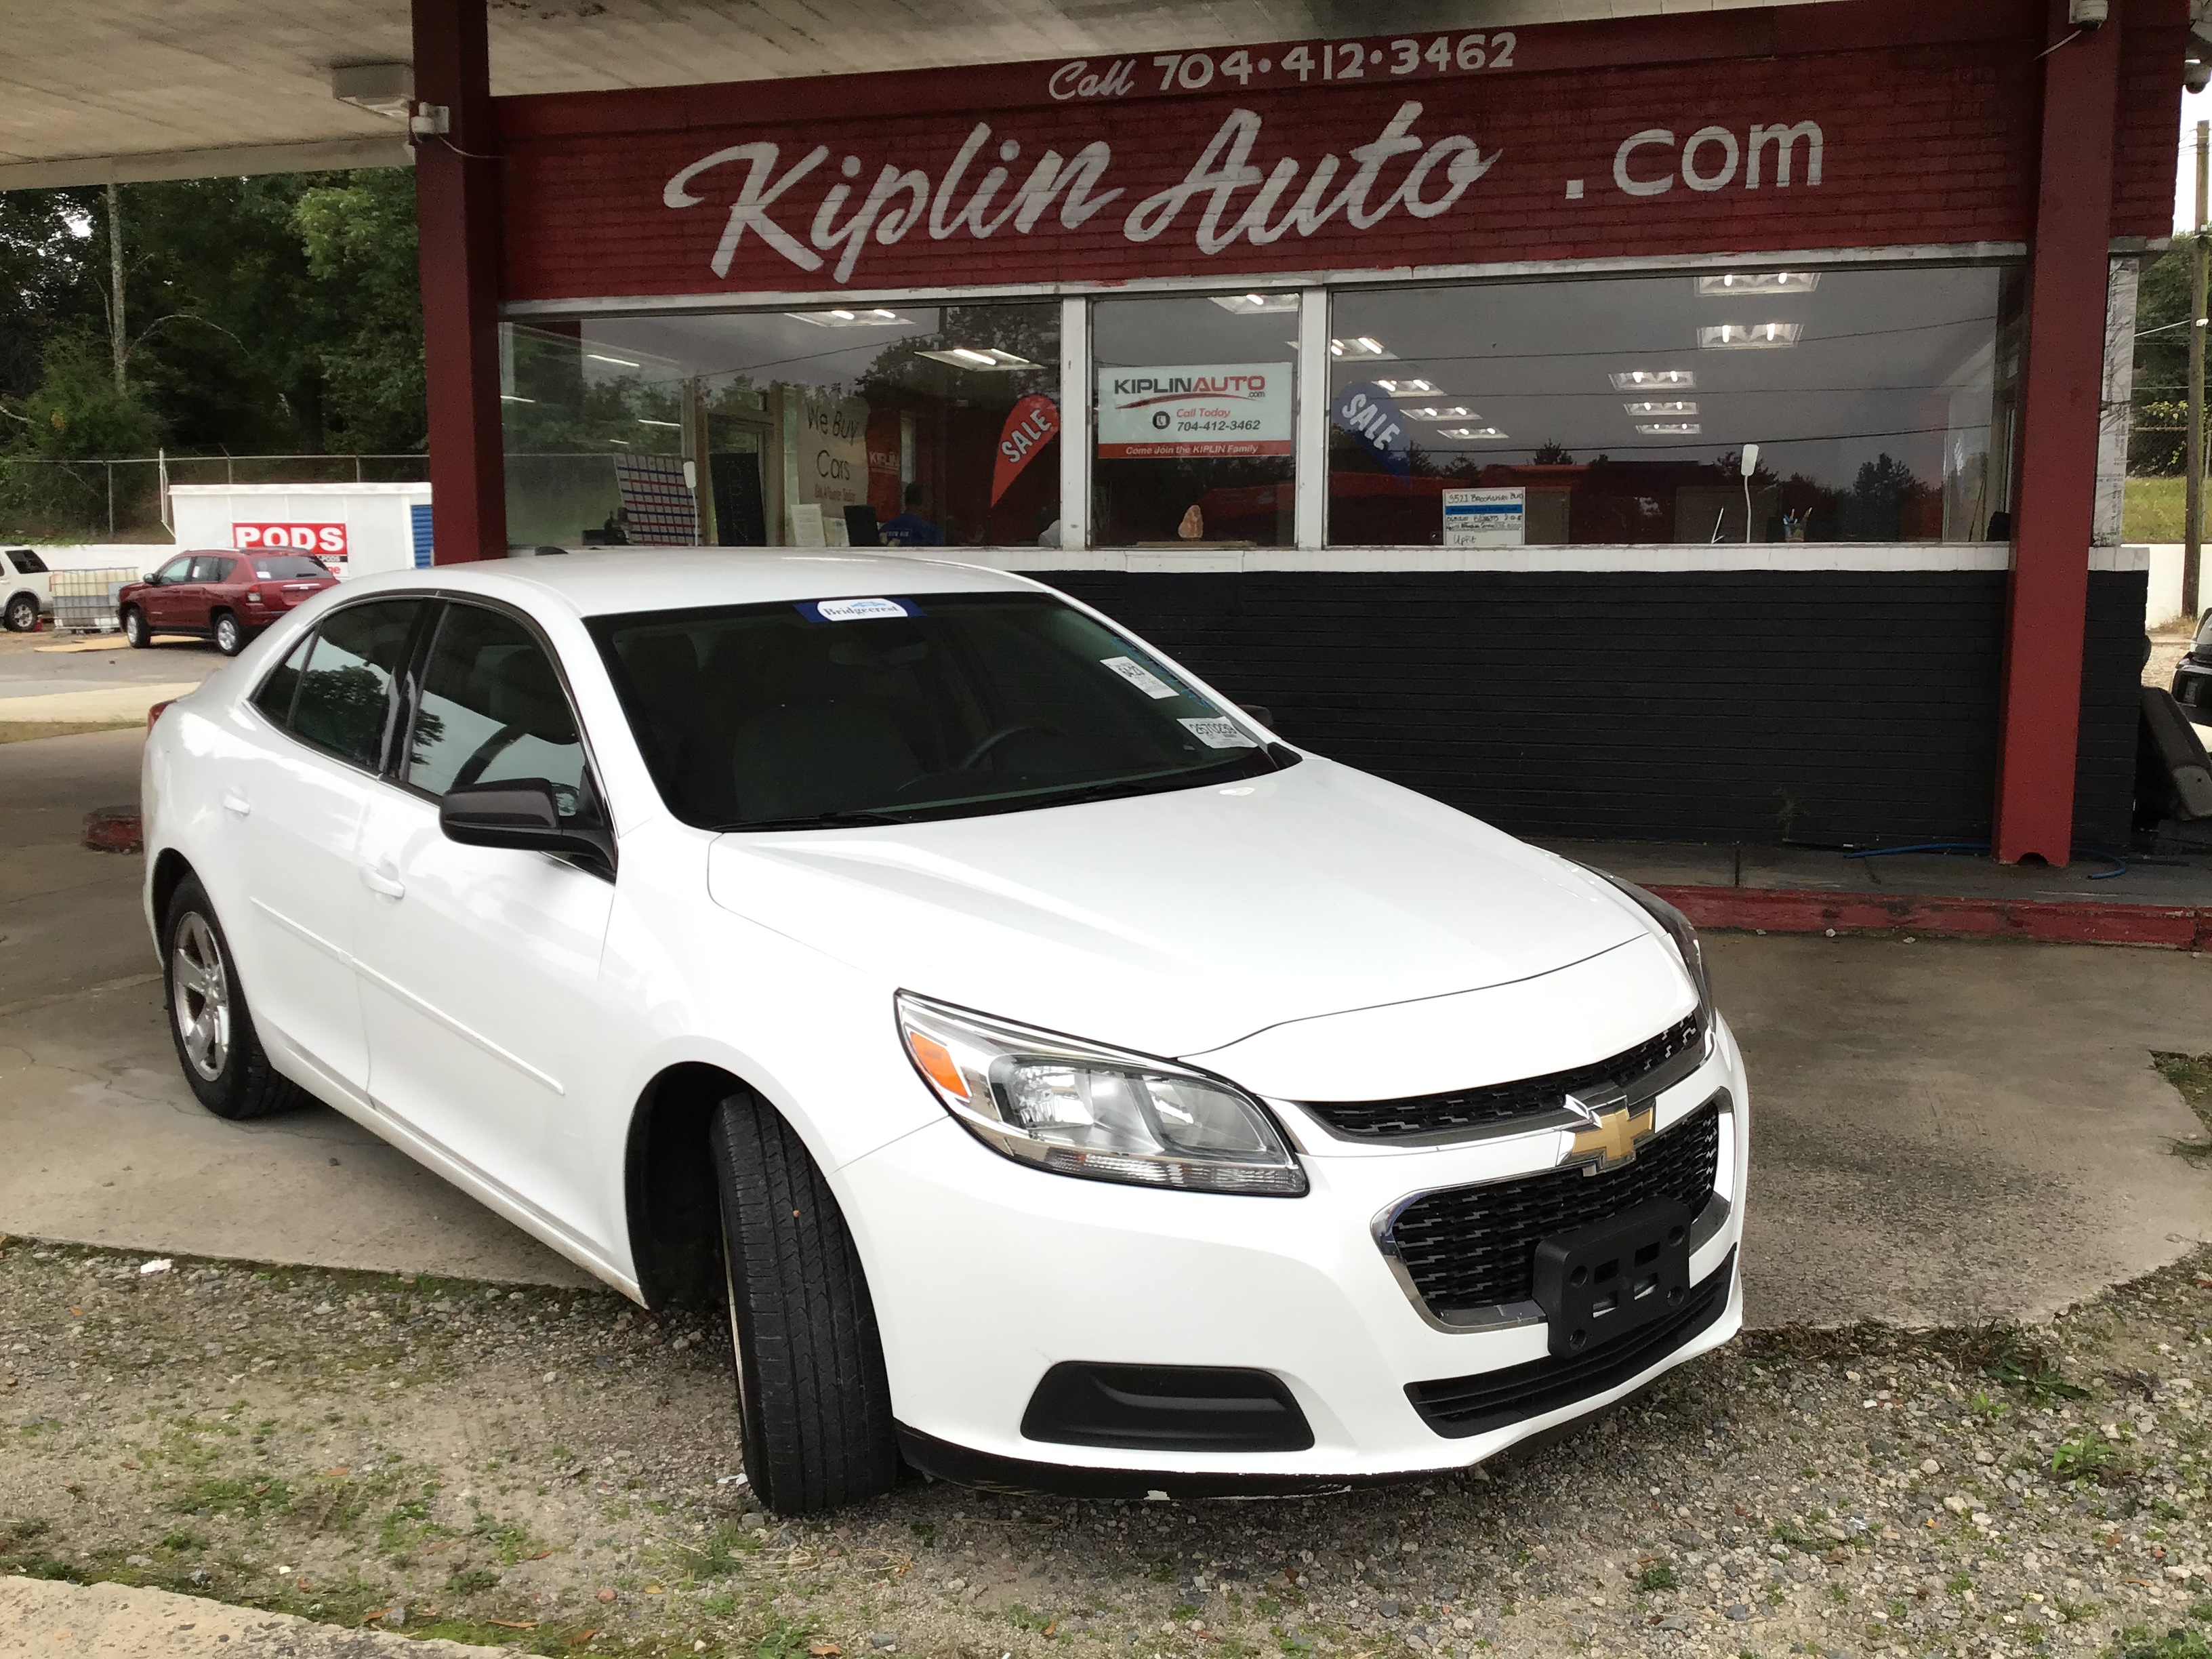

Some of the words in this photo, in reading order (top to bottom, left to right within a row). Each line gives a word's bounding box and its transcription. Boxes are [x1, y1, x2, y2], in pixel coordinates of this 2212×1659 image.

[1048, 59, 1136, 100] Call
[663, 122, 1126, 284] Kiplin
[1123, 100, 1504, 255] Auto
[807, 405, 828, 435] We
[1176, 409, 1196, 418] Call
[1199, 407, 1231, 419] Today
[1177, 419, 1261, 432] 704-412-3462
[1342, 393, 1400, 451] SALE
[1001, 409, 1052, 463] SALE
[1126, 446, 1153, 455] Come
[1153, 445, 1174, 455] Join
[1176, 445, 1190, 454] the
[1193, 445, 1226, 453] KIPLIN
[1227, 444, 1258, 454] Family
[816, 449, 851, 480] Cars
[235, 526, 344, 552] PODS
[822, 605, 899, 616] Bridgecrest
